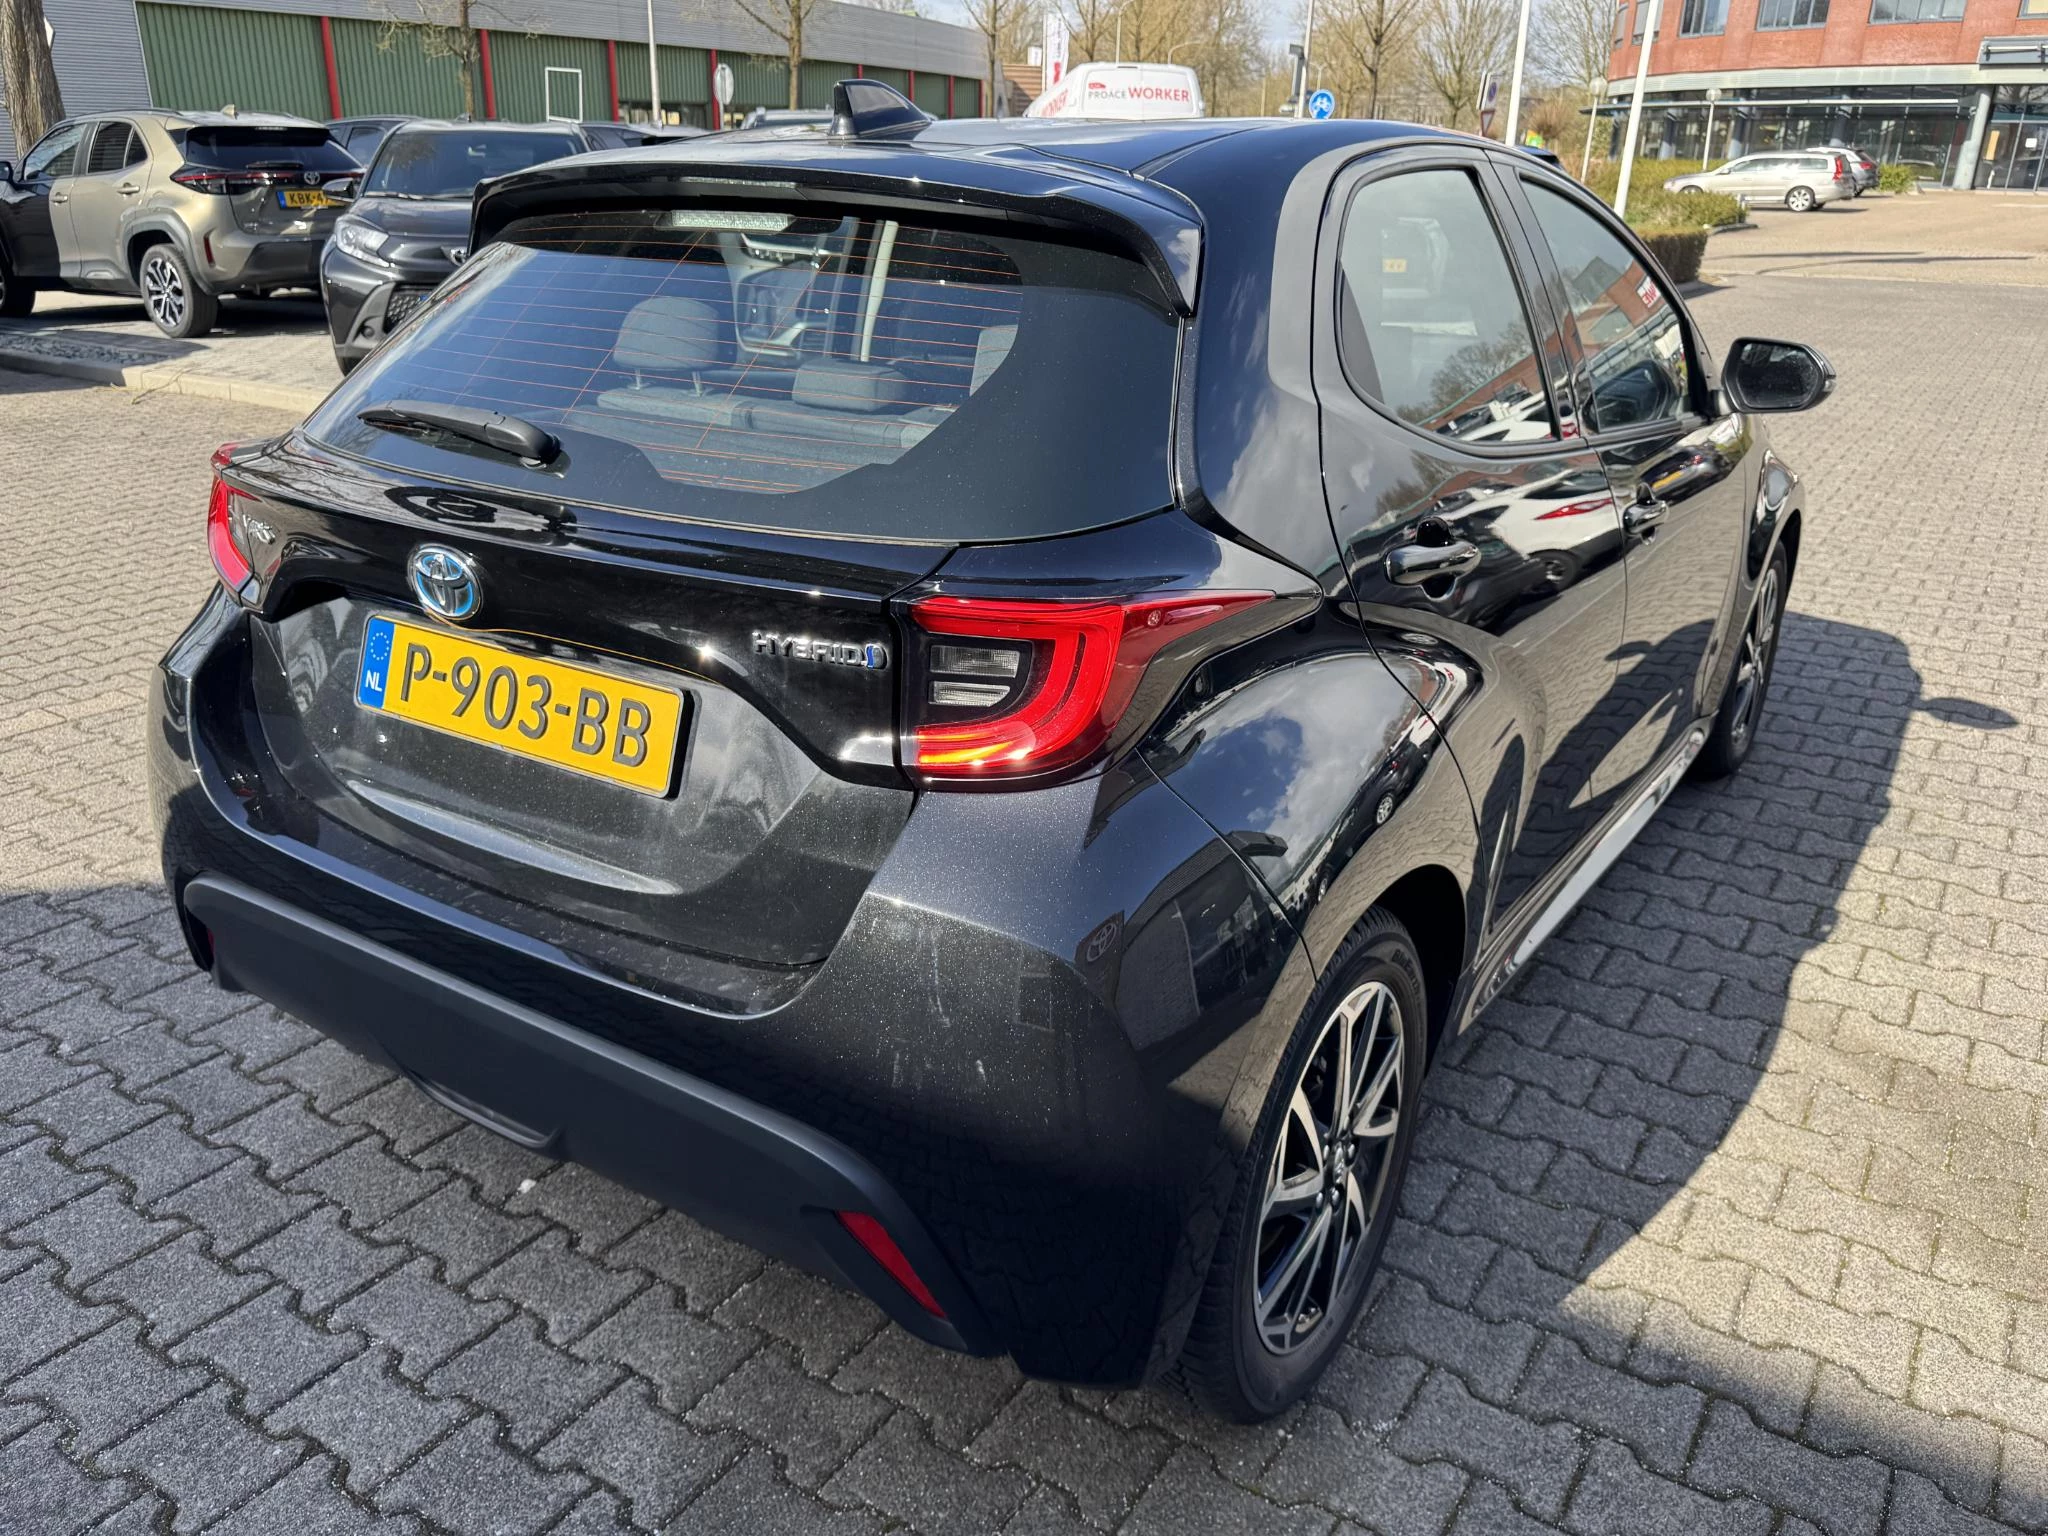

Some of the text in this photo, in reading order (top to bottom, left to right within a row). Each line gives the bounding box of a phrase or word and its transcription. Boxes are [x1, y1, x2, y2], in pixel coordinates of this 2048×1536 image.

[1088, 88, 1189, 102] PROACE WORKER
[365, 642, 652, 768] NL P-903-BB
